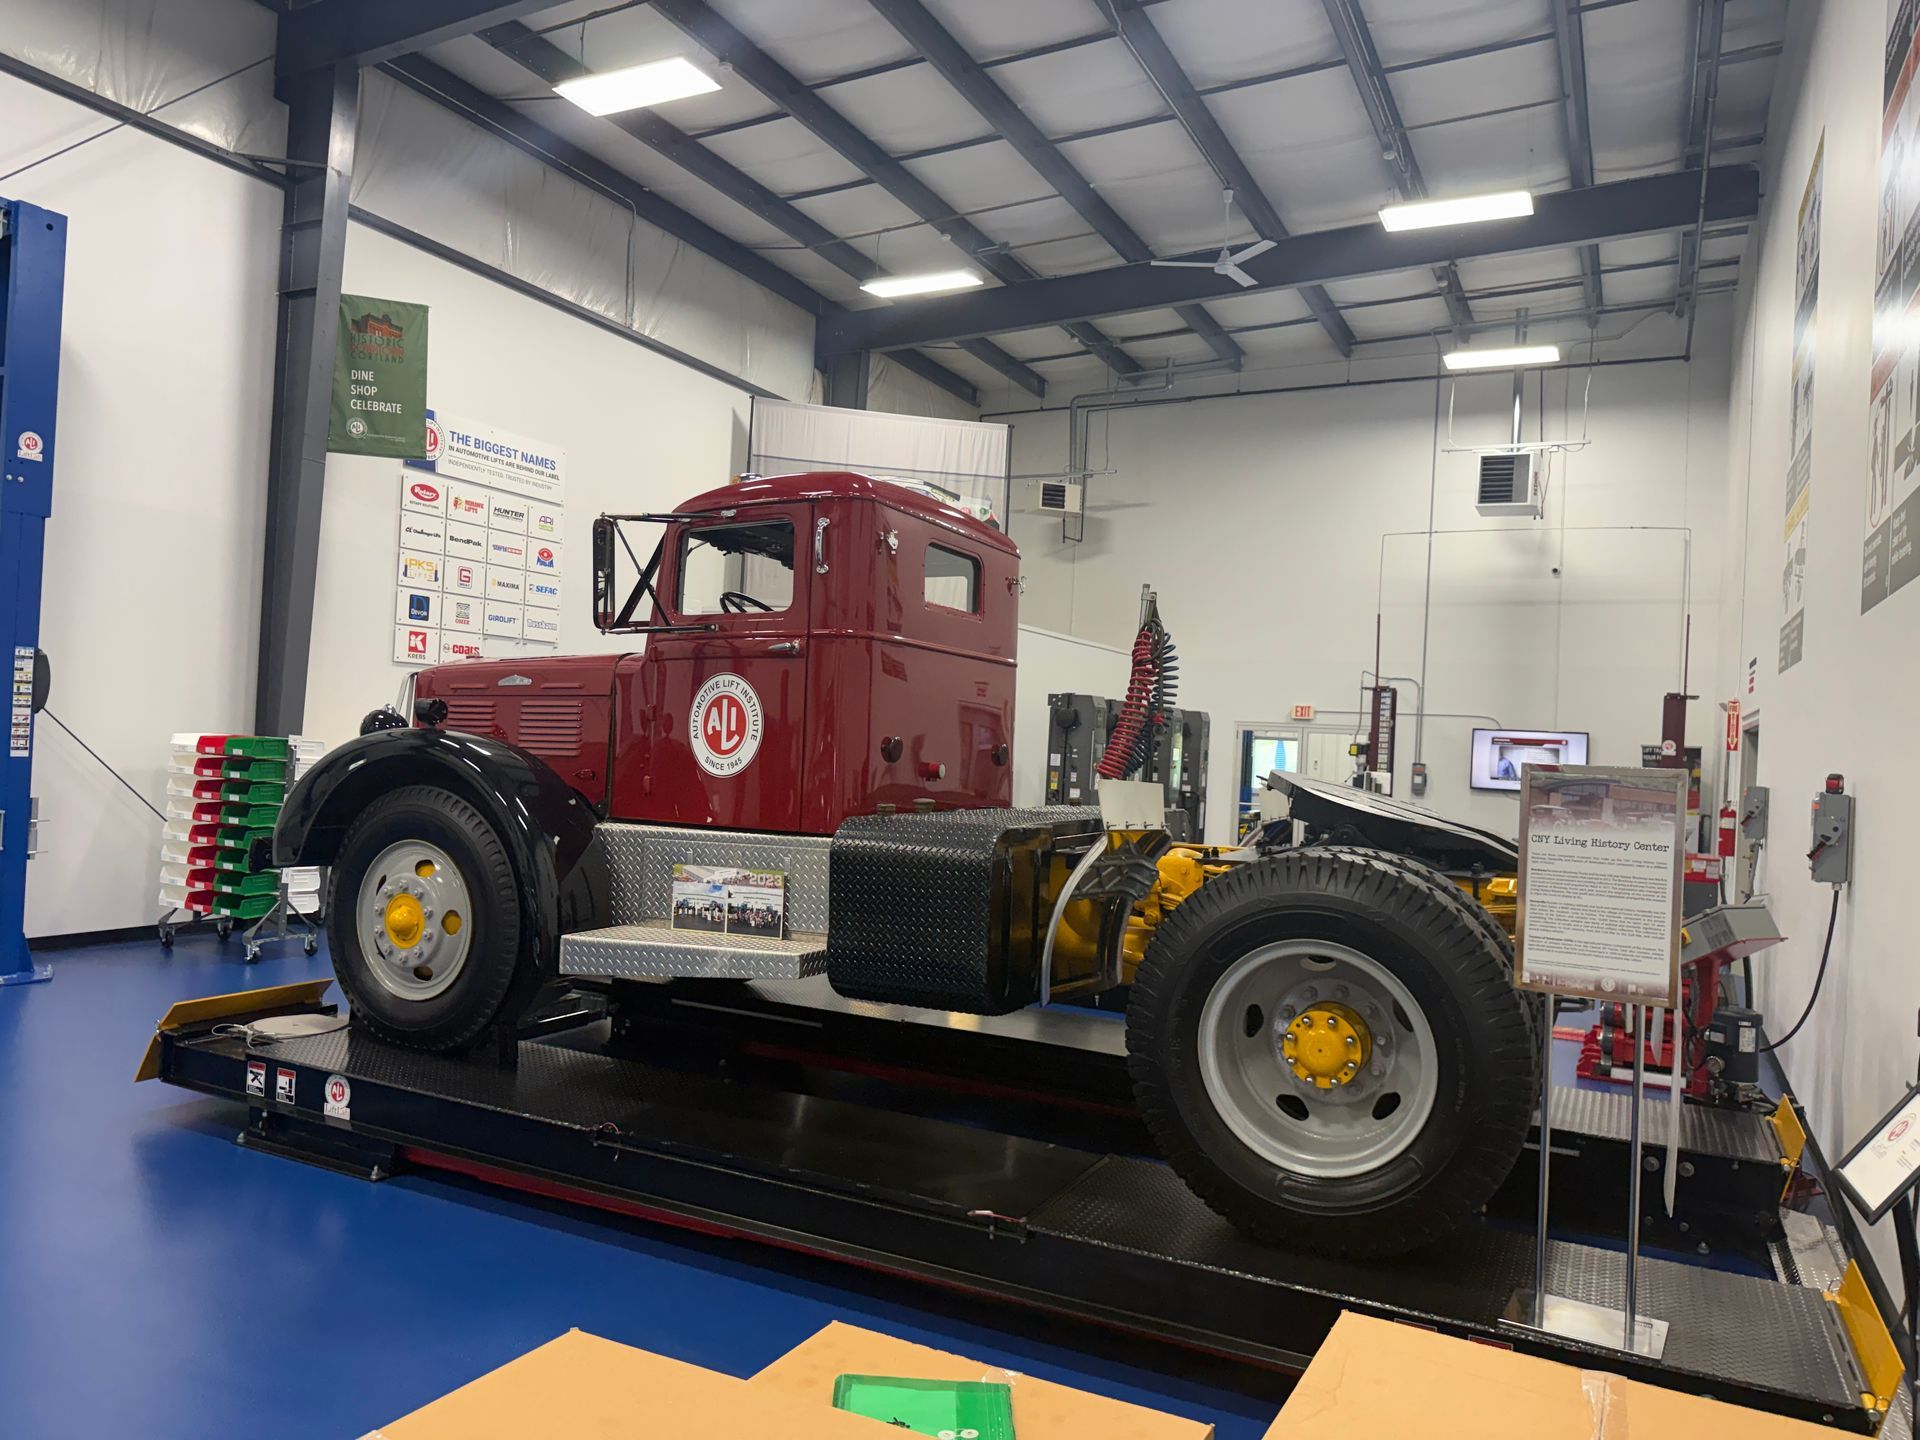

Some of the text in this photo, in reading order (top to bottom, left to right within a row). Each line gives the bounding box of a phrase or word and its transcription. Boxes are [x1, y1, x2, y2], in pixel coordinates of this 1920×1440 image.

[350, 333, 404, 348] HISTORIC
[351, 369, 375, 381] DINE
[350, 384, 378, 396] SHOP
[350, 399, 403, 414] CELEBRATE
[449, 430, 556, 471] THE BIGGEST NAMES
[448, 459, 486, 473] INDEPENDENTLY
[455, 446, 490, 461] AUTOMOTIVE
[490, 456, 505, 466] LIFTS
[505, 460, 516, 469] ARE
[516, 463, 534, 474] BEHIND
[534, 468, 545, 477] OUR
[545, 471, 560, 481] LABEL
[494, 507, 525, 519] HUNTER
[449, 535, 482, 547] BendPak
[409, 558, 434, 572] PKS
[497, 581, 520, 590] MAXIMA
[535, 585, 558, 595] SEFAC
[488, 614, 516, 624] GIROLIFT
[692, 680, 760, 741] AUTOMOTIVE LIFT INSTITUTE
[1296, 705, 1311, 717] EXIT
[707, 699, 740, 750] ALI
[705, 756, 743, 770] SINCE 1945
[1531, 834, 1670, 853] CNY Living History Center
[749, 873, 783, 889] 2023
